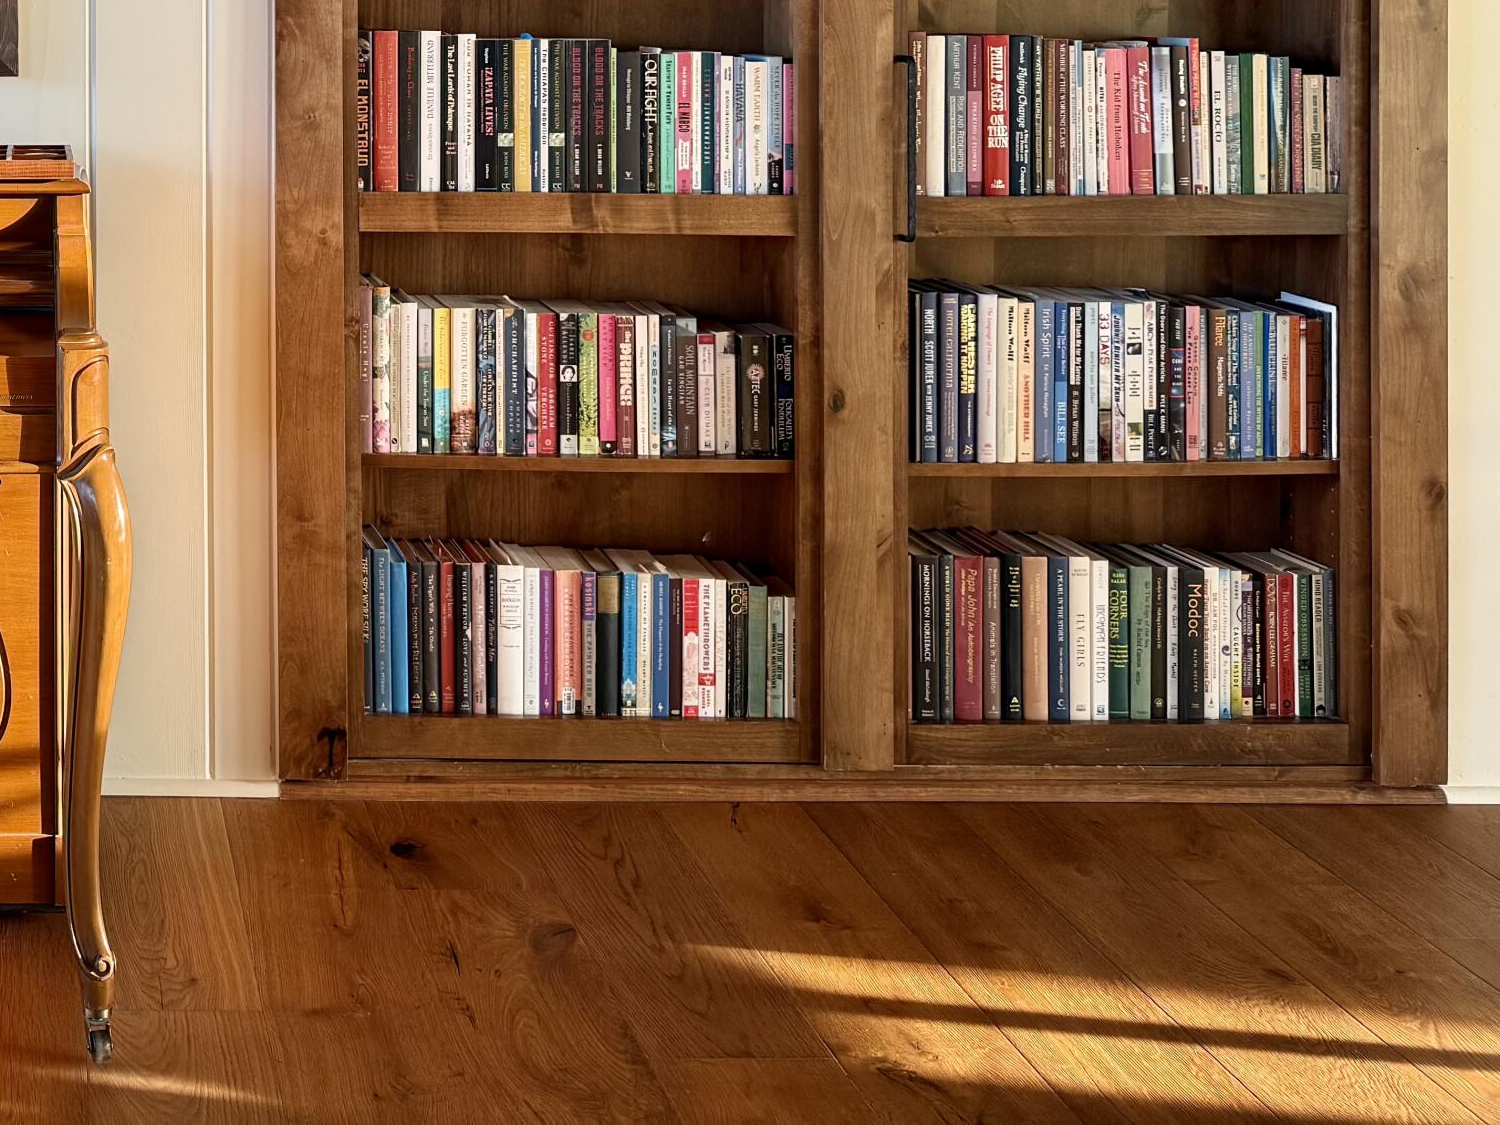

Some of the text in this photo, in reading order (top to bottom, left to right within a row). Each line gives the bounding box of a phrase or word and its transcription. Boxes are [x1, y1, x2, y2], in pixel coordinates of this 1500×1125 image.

[953, 42, 961, 69] ARTHUR
[644, 59, 658, 123] OUR FIGHT
[991, 46, 1003, 111] PHILIP AGEE
[1113, 71, 1121, 85] The
[735, 83, 743, 122] HAVANA
[1016, 67, 1028, 128] Flying Change
[1114, 88, 1122, 103] Kid
[358, 79, 369, 167] EL MONSTRUO
[678, 112, 690, 133] NARCO
[987, 125, 1007, 136] THE
[990, 115, 1004, 125] ON
[1214, 91, 1222, 142] EL ROCÍO
[988, 137, 1008, 148] RUN
[1311, 133, 1321, 170] CIA DIARY
[924, 309, 934, 334] NORTH
[1042, 309, 1051, 358] Irish Spirit
[925, 341, 934, 362] SCOTT
[1100, 313, 1110, 365] 33 DAYS
[686, 345, 694, 415] SOUL MOUNTAIN
[925, 363, 934, 384] JUREK
[925, 395, 933, 413] JENNY
[925, 414, 933, 432] JUREK
[1057, 401, 1066, 443] BILL SEE
[966, 569, 977, 592] Papa
[584, 576, 594, 616] kosinski
[730, 588, 742, 615] ECO
[1119, 590, 1127, 619] FOUR
[924, 607, 931, 618] ON
[1110, 590, 1119, 639] CORNERS
[1188, 584, 1202, 637] Modoc
[702, 584, 710, 671] THE FLAMETHROWERS
[989, 621, 997, 648] Animals
